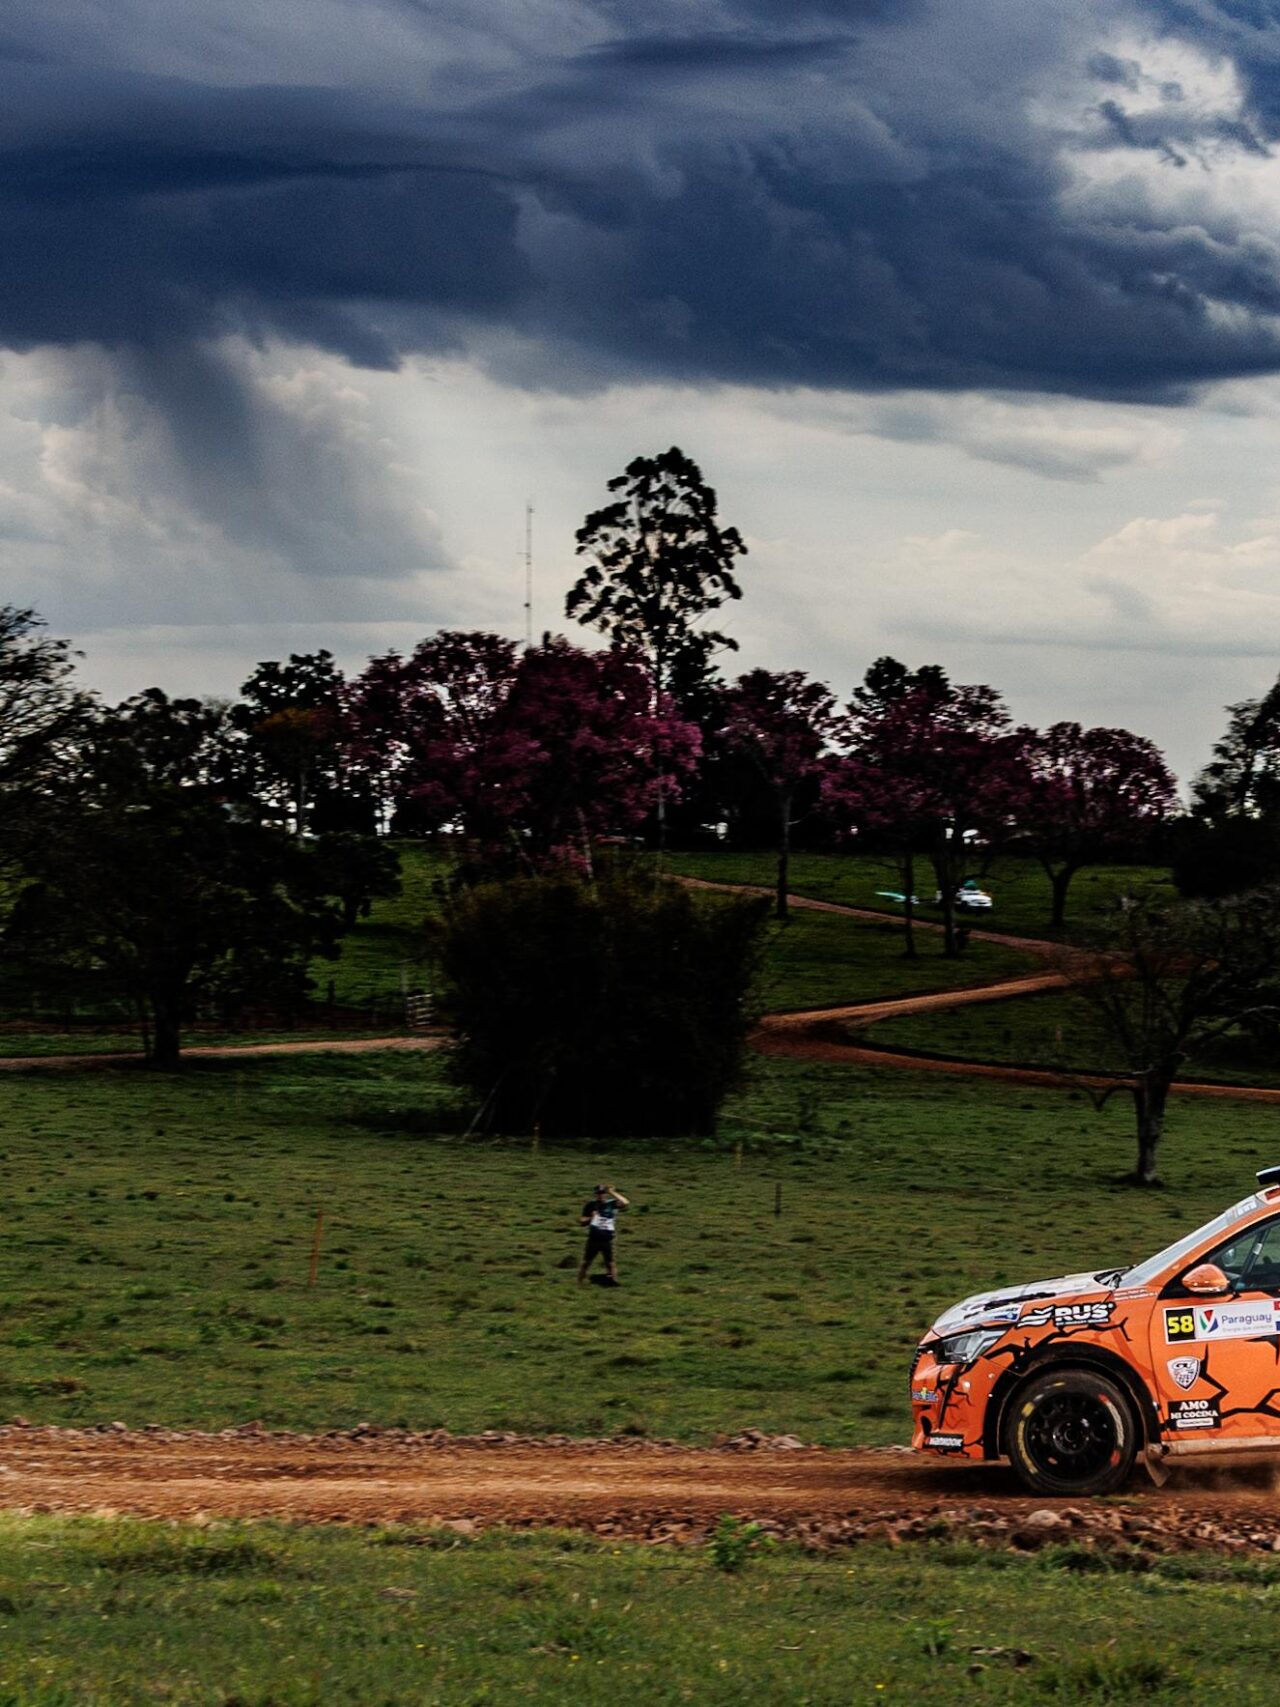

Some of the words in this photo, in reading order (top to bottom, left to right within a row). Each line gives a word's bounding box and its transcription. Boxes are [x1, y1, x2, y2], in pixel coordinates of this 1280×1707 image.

[1054, 1303, 1109, 1322] RUS
[1167, 1315, 1194, 1334] 58
[1221, 1313, 1273, 1325] Paraguay
[1179, 1400, 1209, 1411] AMO
[1170, 1411, 1182, 1420] MI
[1183, 1409, 1219, 1419] COCINA
